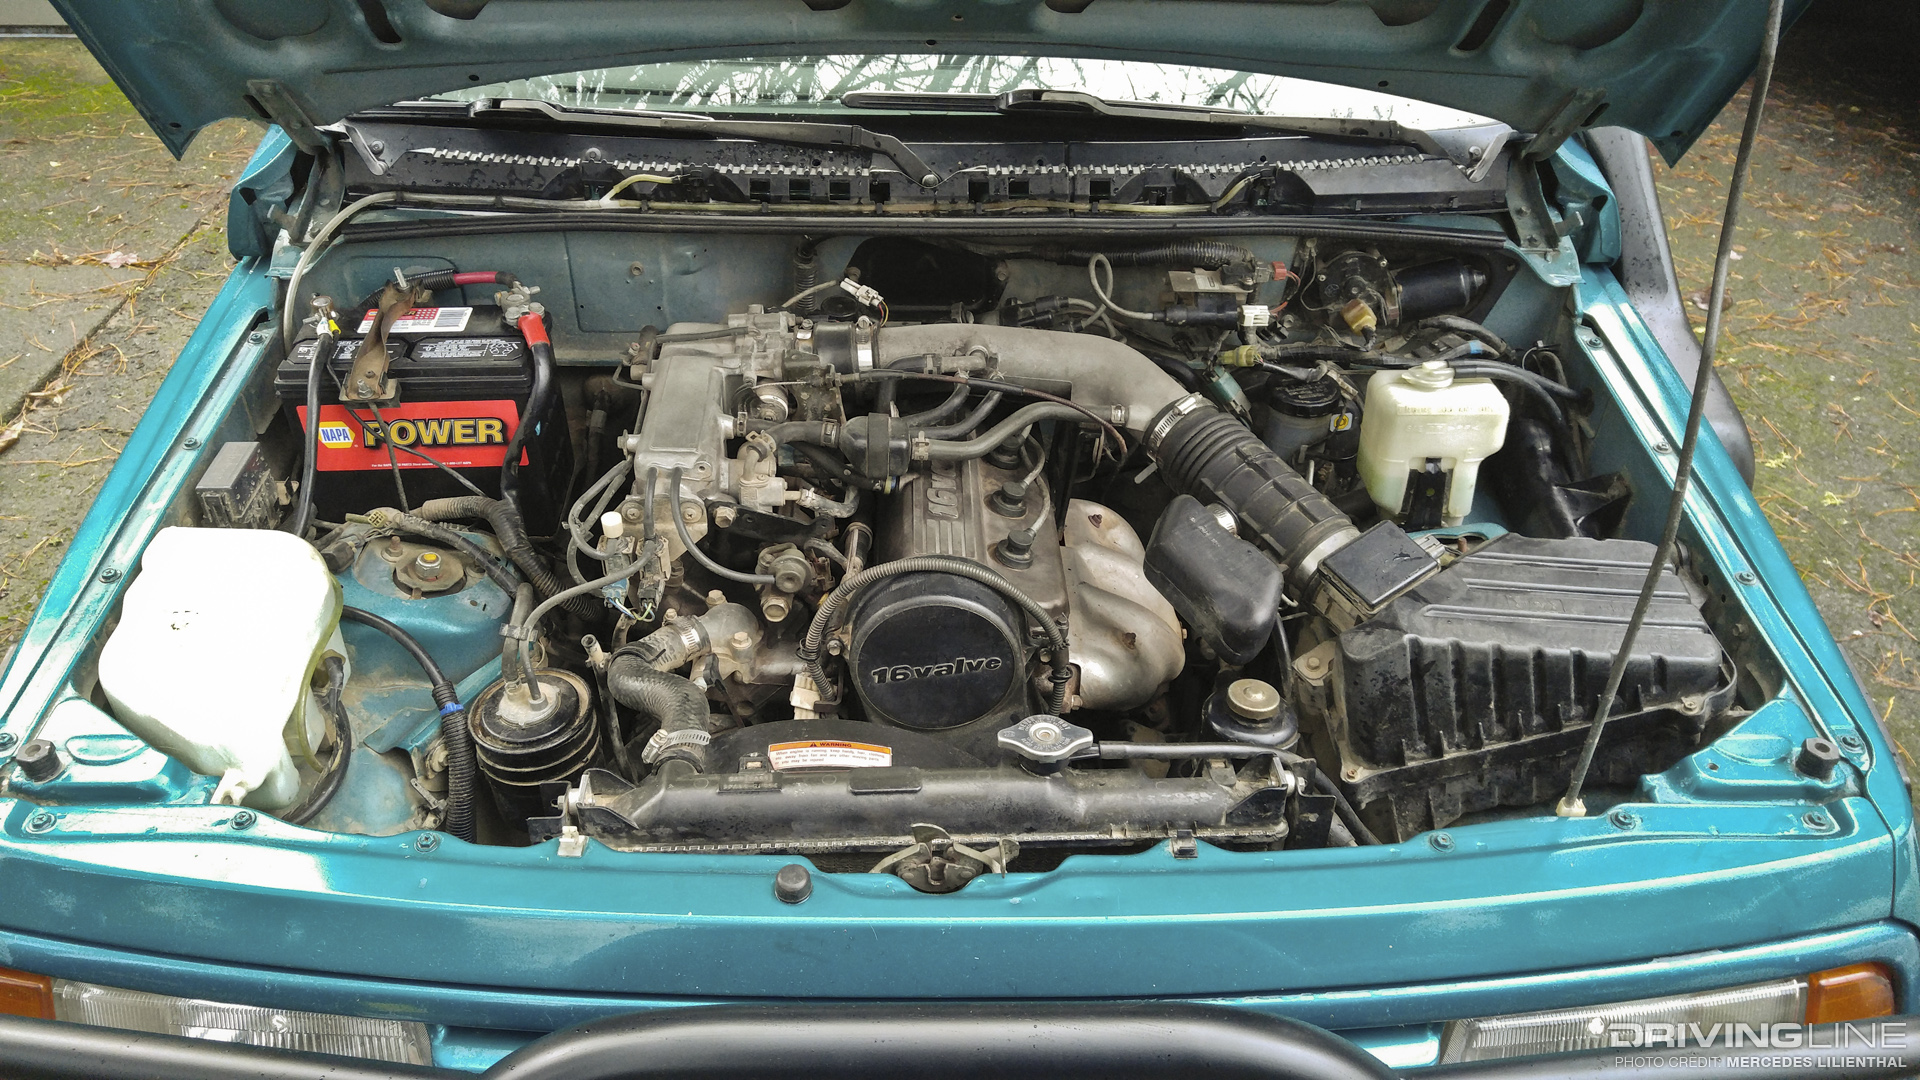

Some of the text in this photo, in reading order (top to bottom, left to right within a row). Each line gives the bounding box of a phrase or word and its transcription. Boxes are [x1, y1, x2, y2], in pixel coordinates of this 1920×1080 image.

[321, 428, 351, 442] NAPA
[363, 418, 504, 447] POWER
[871, 656, 1002, 684] 16valve
